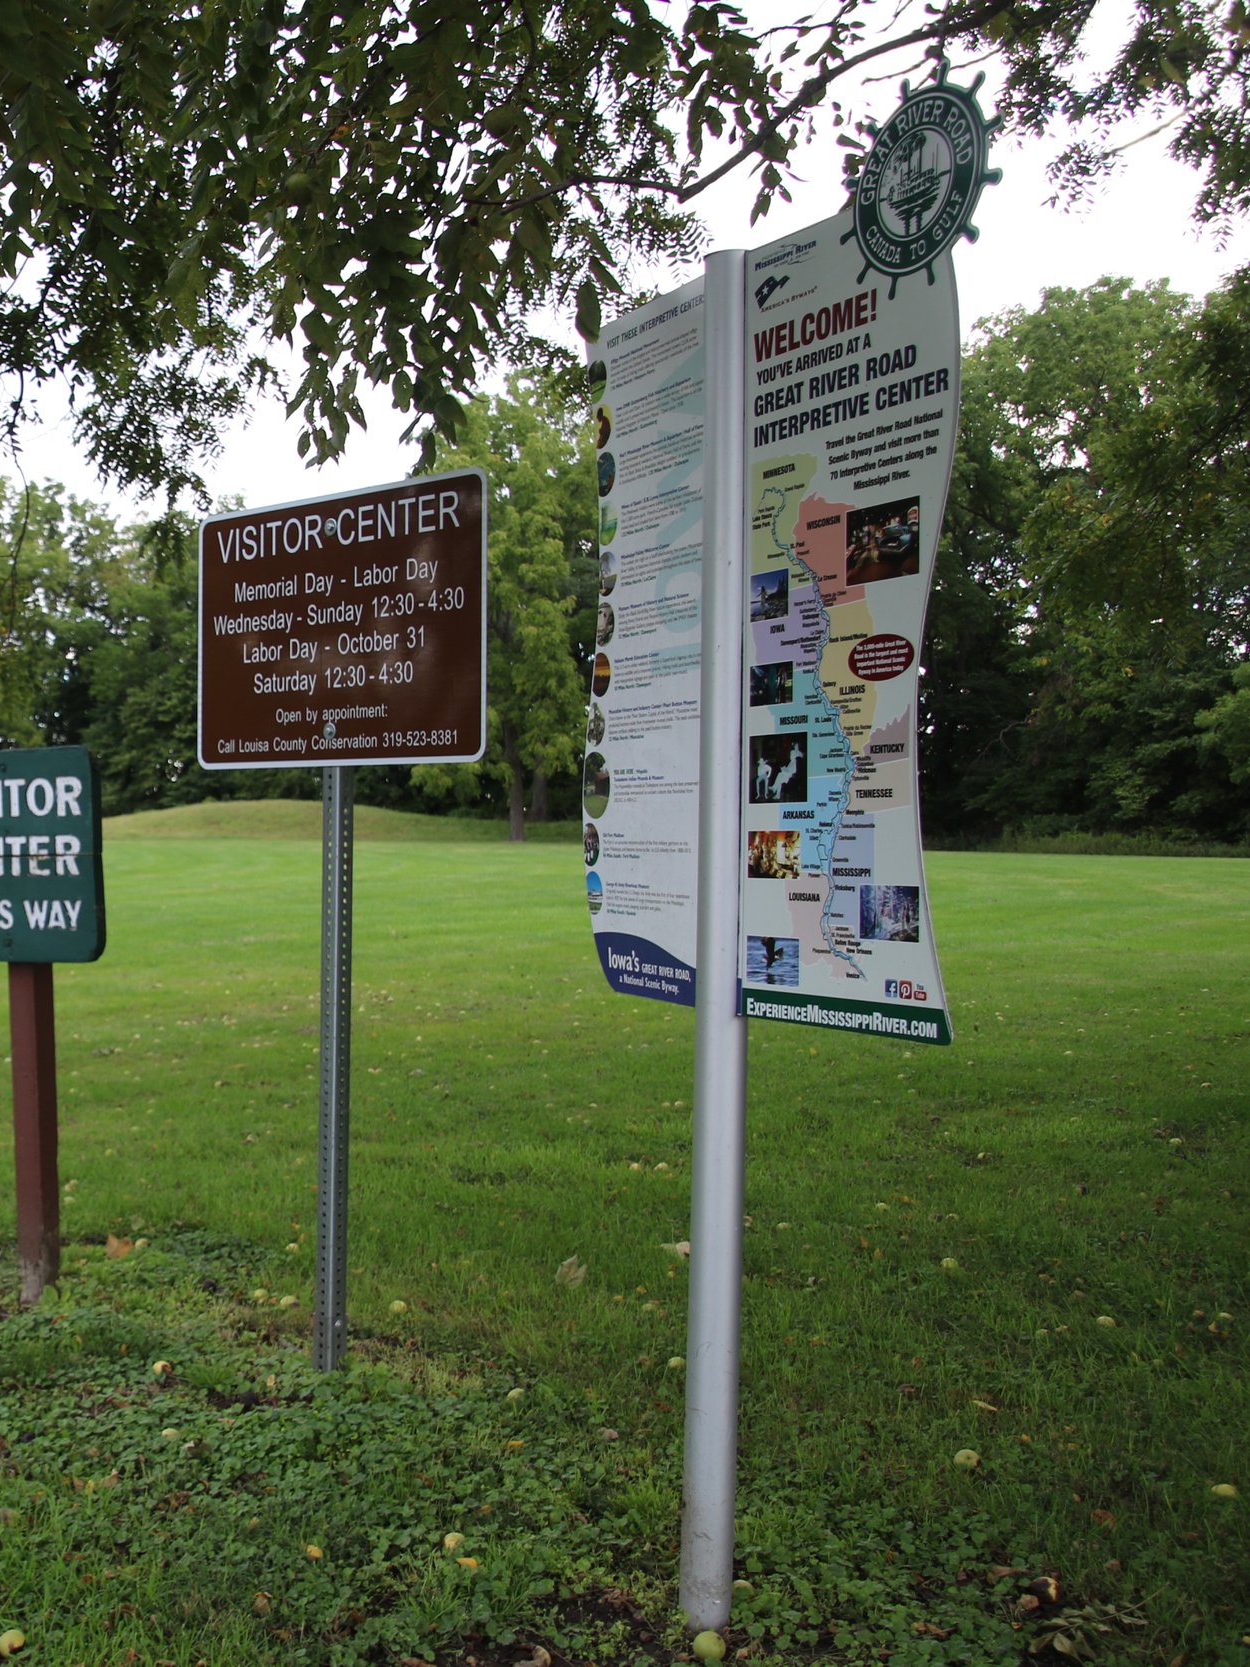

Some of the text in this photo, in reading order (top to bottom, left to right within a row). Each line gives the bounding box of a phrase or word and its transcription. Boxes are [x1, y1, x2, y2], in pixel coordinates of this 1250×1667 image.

[862, 100, 972, 205] GREAT RIVER ROAD
[866, 190, 963, 262] CANADA TO GULF
[606, 335, 620, 350] VISIT
[622, 326, 638, 342] THESE
[639, 306, 678, 334] INTERPRETIVE
[754, 288, 877, 363] WELCOME!
[756, 333, 871, 386] YOU'VE ARRIVED AT A
[754, 344, 917, 417] GREAT RIVER ROAD
[754, 392, 870, 448] INTERPRETIVE
[876, 368, 949, 410] CENTER
[826, 408, 943, 450] Travel the Great River Road National
[828, 428, 939, 466] Scenic Byway and visit more than
[830, 446, 937, 480] 70 Interpretive Centers along the
[763, 463, 796, 480] MINNESOTA
[854, 470, 910, 490] Mississippi River.
[217, 490, 460, 564] VISITOR CENTER
[806, 514, 840, 531] WISCONSIN
[234, 575, 298, 603] Memorial
[304, 572, 334, 596] Day
[354, 564, 398, 588] Labor
[406, 557, 438, 582] Day
[214, 608, 294, 636] Wednesday
[307, 601, 364, 626] Sunday
[371, 593, 414, 618] 12:30
[428, 586, 464, 612] 4:30
[243, 642, 282, 664] Labor
[289, 638, 318, 662] Day
[337, 630, 399, 656] October
[406, 625, 425, 649] 31
[770, 624, 786, 634] IOWA
[254, 671, 317, 696] Saturday
[324, 664, 366, 689] 12:30
[378, 660, 414, 685] 4:30
[839, 684, 866, 696] ILLINOIS
[276, 703, 388, 725] Open by appointment:
[780, 714, 808, 726] MISSOURI
[218, 730, 458, 754] Call Louisa County Conservation 319-523-8381
[870, 743, 905, 754] KENTUCKY
[856, 788, 892, 798] TENNESSEE
[782, 810, 814, 820] ARKANSAS
[832, 868, 870, 877] MISSISSIPPI
[788, 892, 820, 902] LOUISIANA
[24, 899, 82, 930] WAY
[608, 947, 691, 982] Iowa's GREAT RIVER ROAD,
[624, 974, 644, 986] National
[645, 979, 660, 990] Scenic
[662, 981, 680, 994] Byway.
